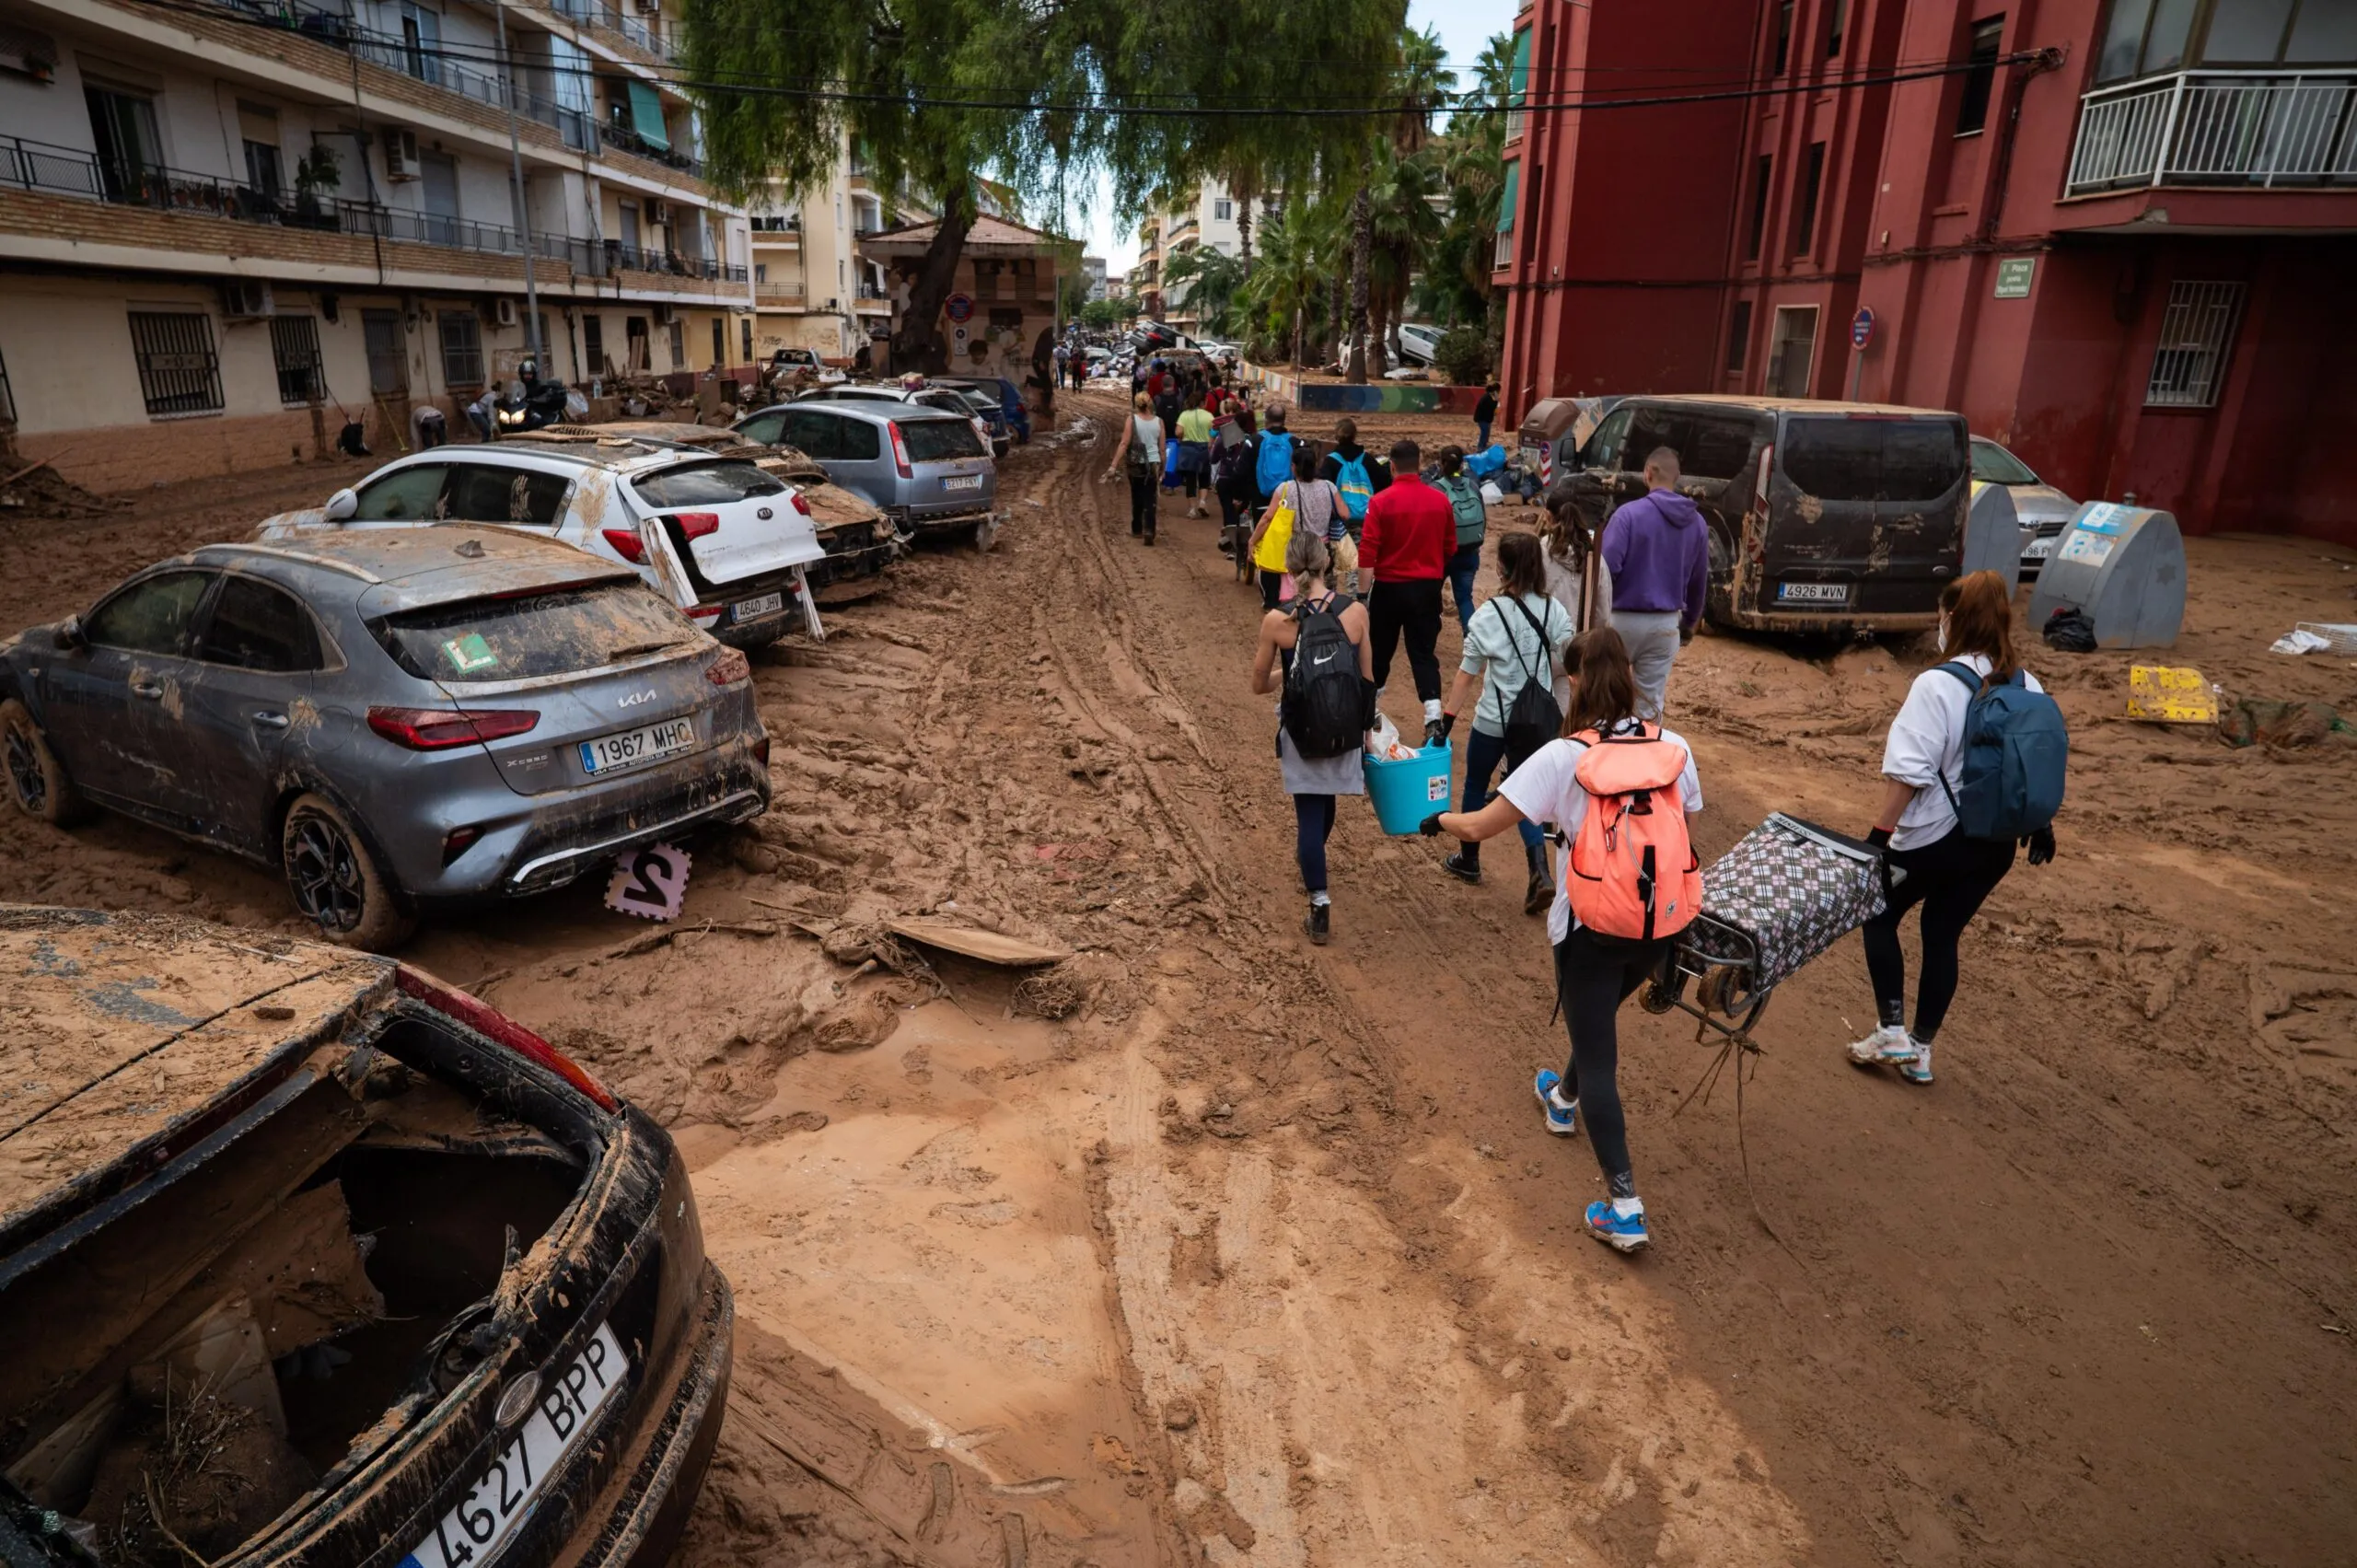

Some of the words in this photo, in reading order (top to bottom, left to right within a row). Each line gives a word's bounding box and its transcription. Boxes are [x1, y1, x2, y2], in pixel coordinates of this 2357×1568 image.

[760, 508, 772, 518] KIA
[1786, 585, 1817, 598] 4926
[1821, 585, 1845, 598] MVN
[739, 599, 761, 617] 4640
[765, 594, 781, 614] JHV
[618, 691, 656, 709] KIA
[598, 733, 644, 764] 1967
[436, 1430, 532, 1568] 4627
[540, 1337, 606, 1442] BPP
